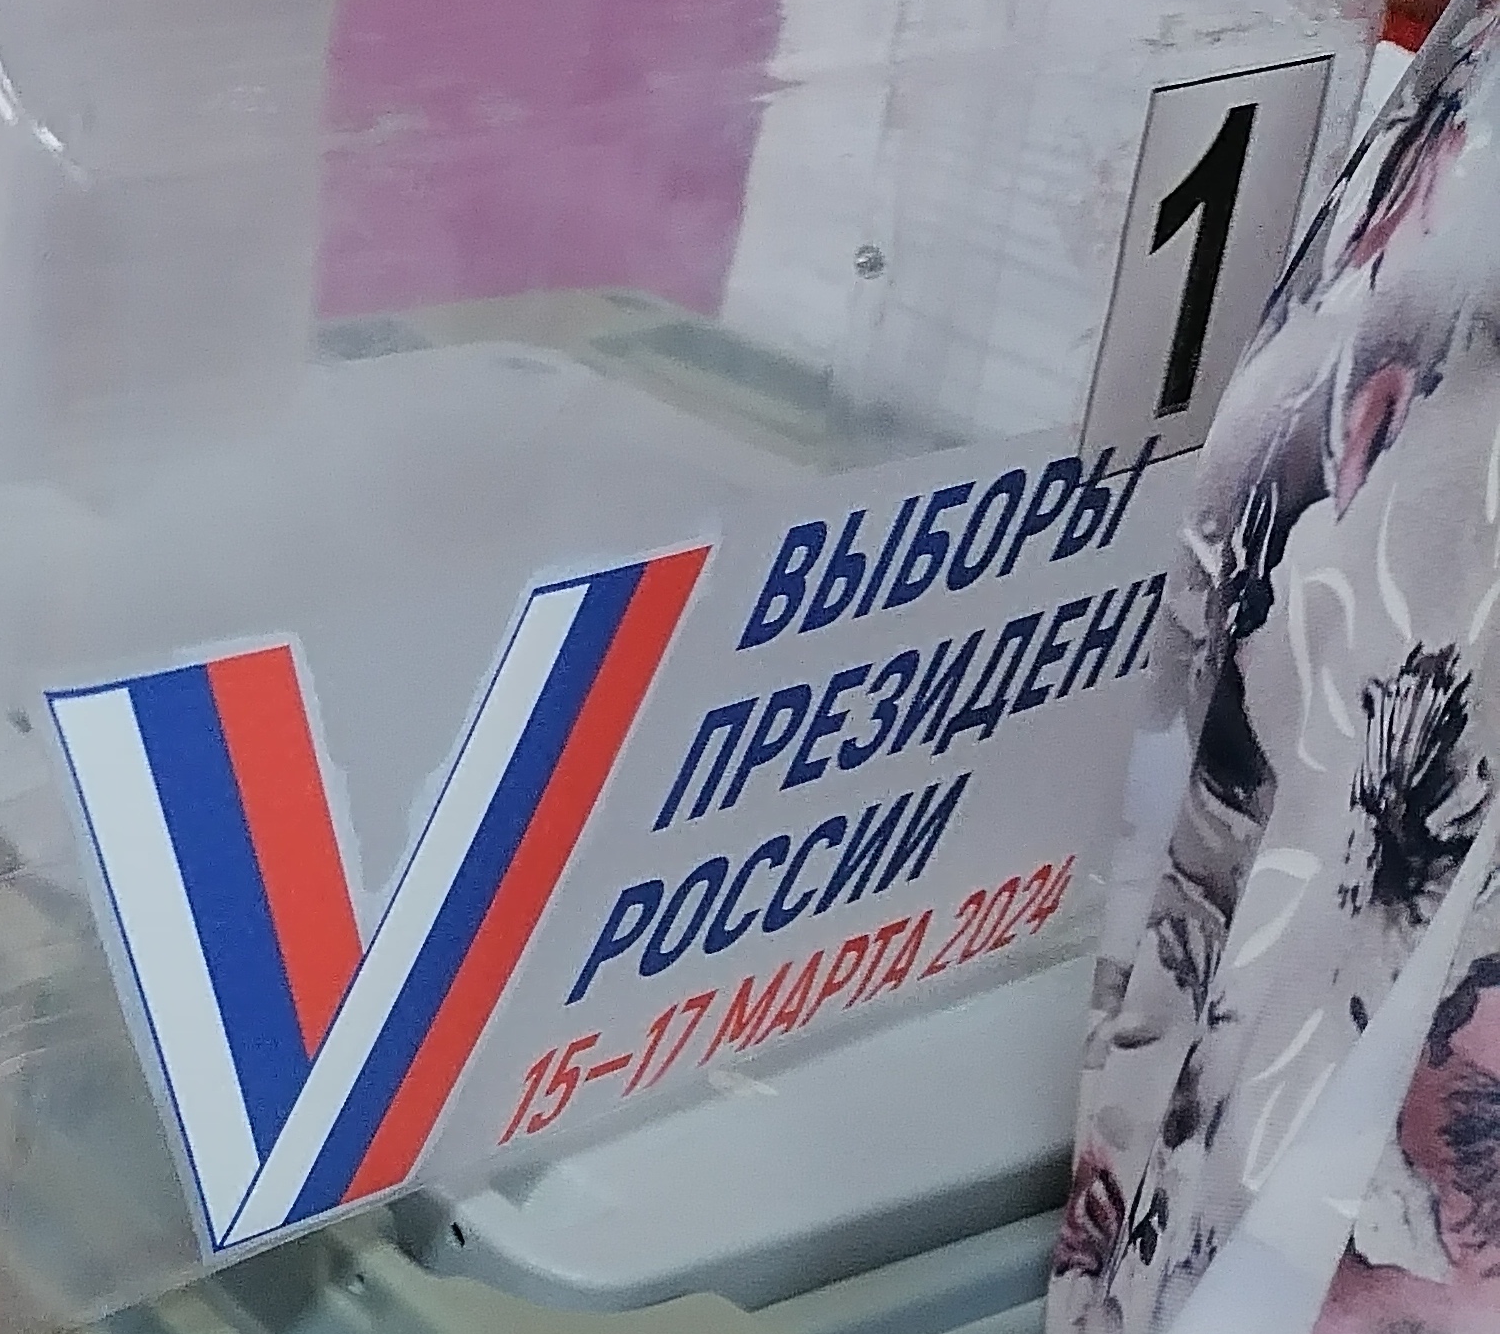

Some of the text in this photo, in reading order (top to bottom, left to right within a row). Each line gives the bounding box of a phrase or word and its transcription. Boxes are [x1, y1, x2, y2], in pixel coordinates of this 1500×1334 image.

[1150, 102, 1259, 419] 1
[737, 435, 1161, 650] ВЫБОРЫ
[653, 572, 1168, 832] ПРЕЗИДЕНТ
[565, 773, 972, 1006] РОССИИ
[699, 909, 933, 1067] МАРТА
[918, 855, 1076, 982] 2024
